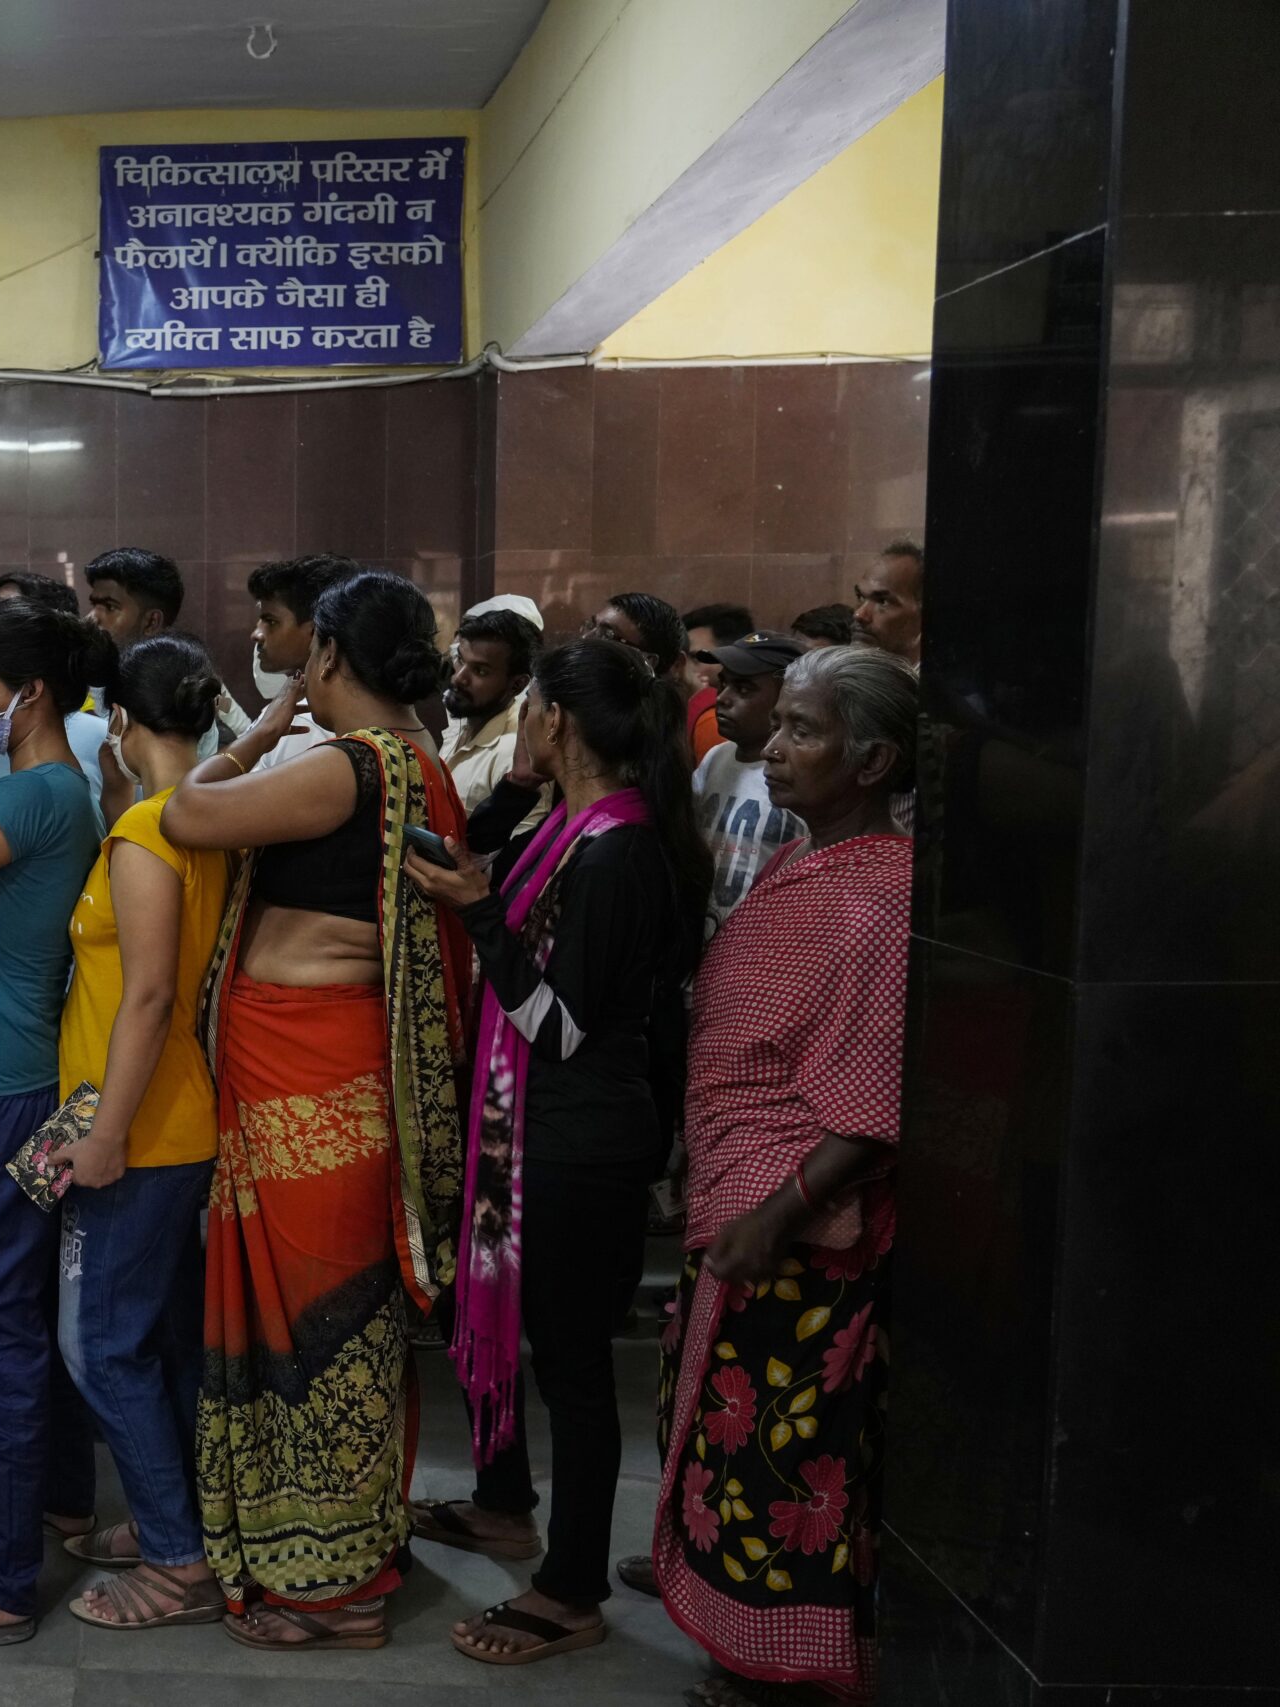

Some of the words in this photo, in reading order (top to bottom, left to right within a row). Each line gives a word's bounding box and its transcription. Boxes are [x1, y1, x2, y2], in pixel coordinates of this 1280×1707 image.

[115, 155, 302, 188] चिकित्सालय
[311, 151, 413, 183] परिसर
[419, 146, 454, 181] में
[127, 202, 295, 228] अनावश्यक
[303, 192, 398, 225] गंदगी
[405, 199, 436, 223] न
[235, 234, 340, 267] क्योंकि
[348, 234, 445, 269] इसको
[169, 278, 268, 310] आपके
[276, 277, 347, 309] जैसा
[355, 275, 390, 309] ही
[125, 320, 221, 352] व्यक्ति
[229, 324, 304, 351] साफ
[311, 323, 401, 349] करता
[408, 315, 436, 349] है
